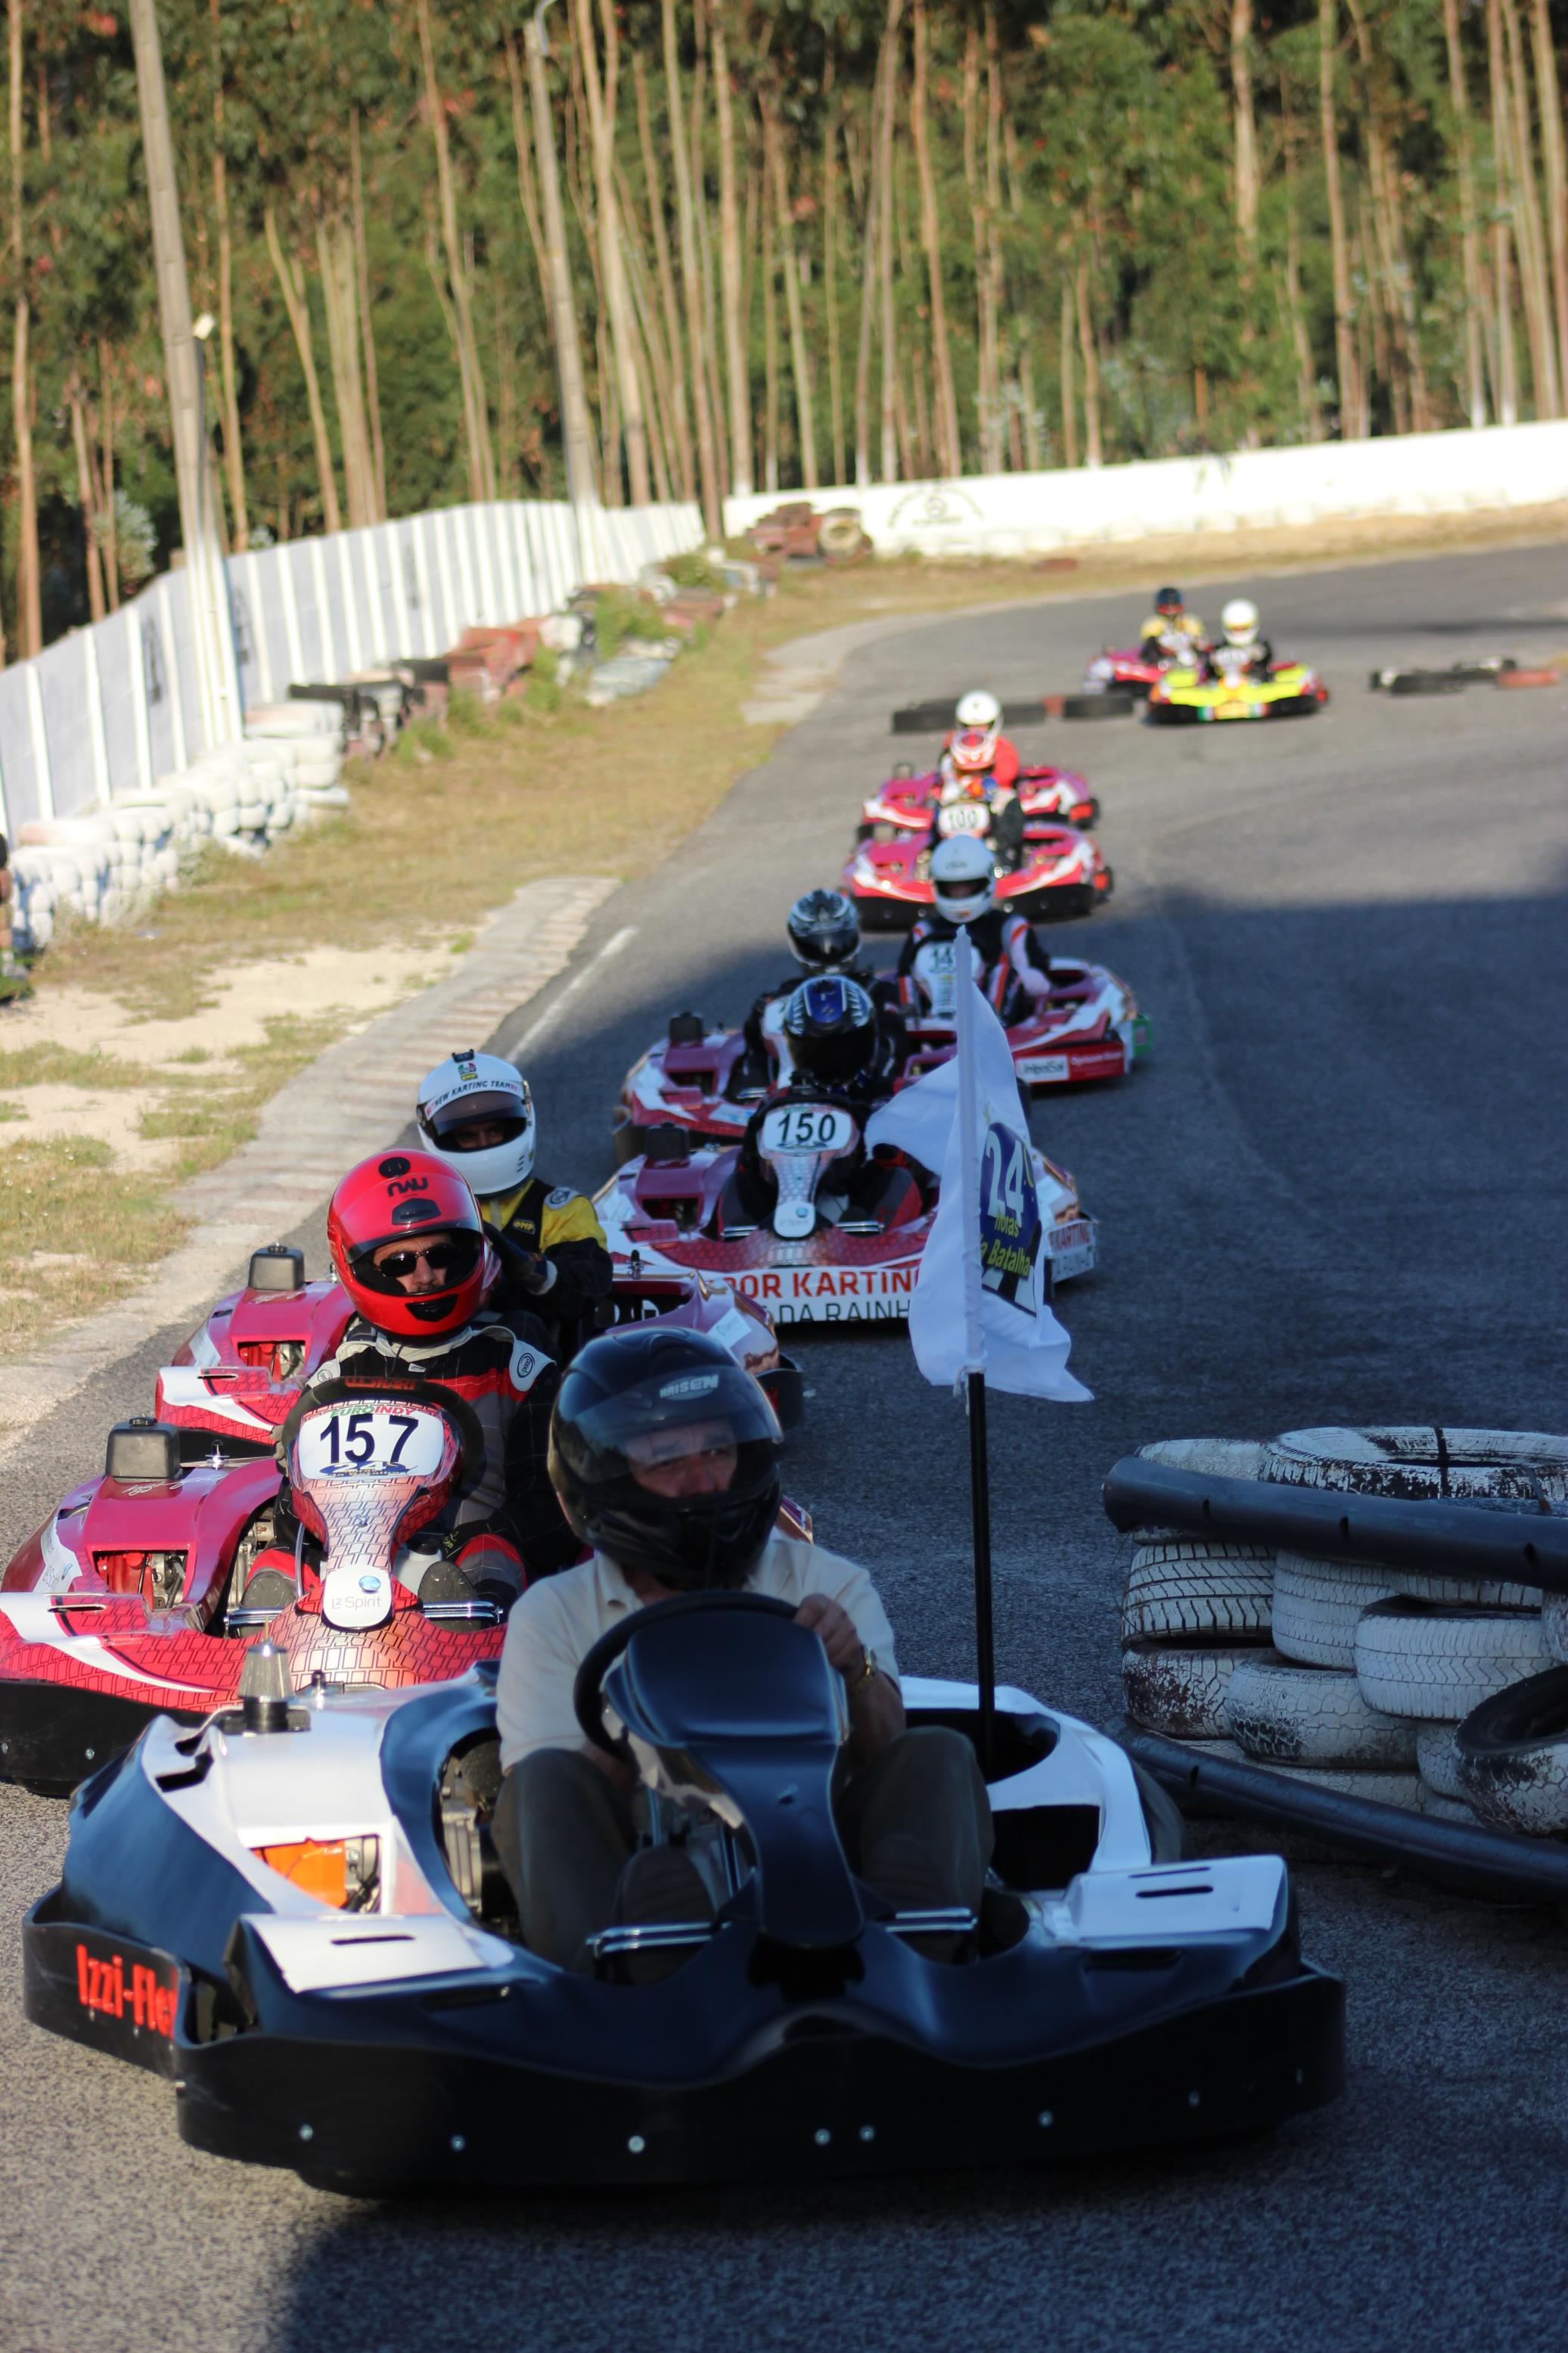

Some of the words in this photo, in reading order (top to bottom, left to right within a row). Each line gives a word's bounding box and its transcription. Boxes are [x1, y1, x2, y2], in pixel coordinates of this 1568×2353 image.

[434, 1091, 450, 1106] NEW
[451, 1081, 488, 1096] KARTING
[491, 1080, 511, 1089] TEAM
[778, 1112, 835, 1142] 150
[986, 1130, 1023, 1229] 24
[988, 1239, 1030, 1276] Batalha
[793, 1269, 919, 1298] KARTIN
[825, 1300, 910, 1322] RAINH
[320, 1413, 419, 1464] 157
[345, 1596, 381, 1611] Spirit
